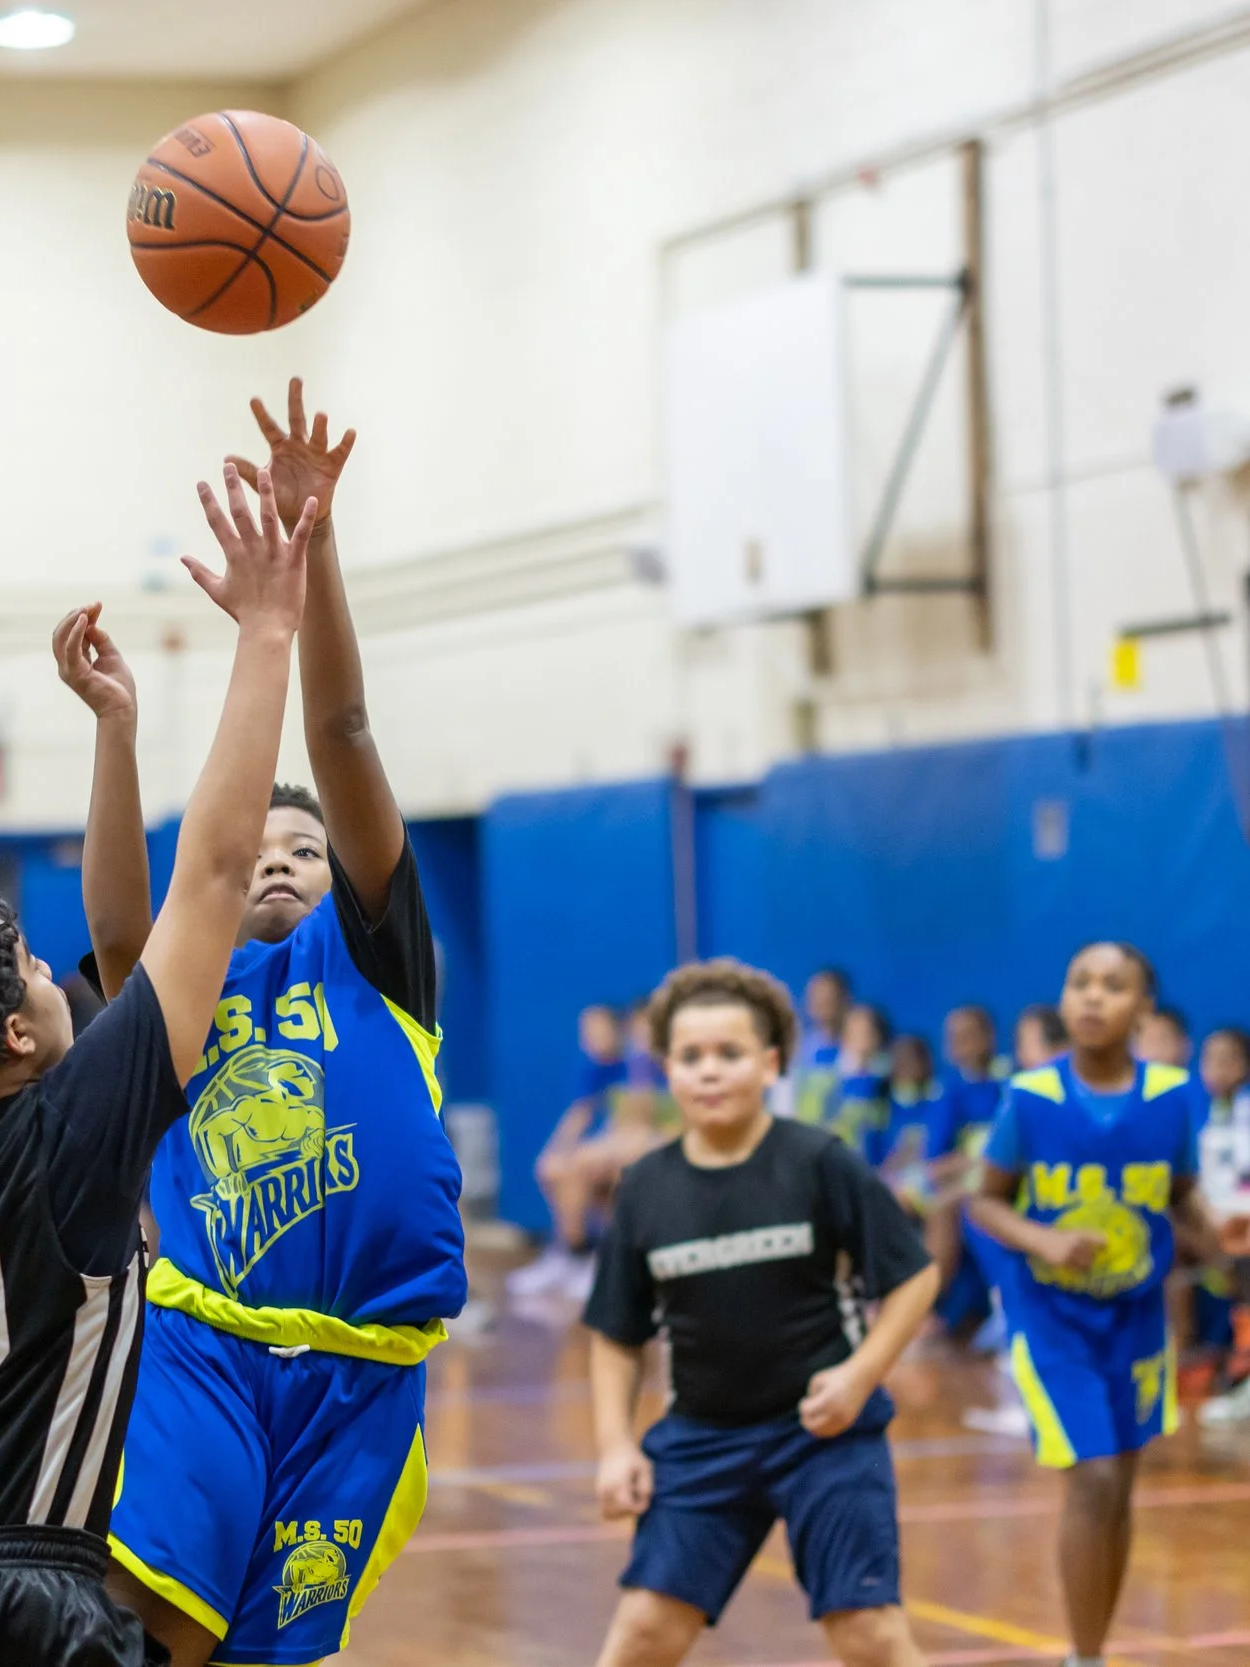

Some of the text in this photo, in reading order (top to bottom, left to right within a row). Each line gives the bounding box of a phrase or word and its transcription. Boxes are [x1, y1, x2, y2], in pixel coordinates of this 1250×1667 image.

[191, 994, 267, 1077] .S.
[273, 1519, 363, 1553] M.S. 50
[272, 1577, 350, 1630] WARRIORS
